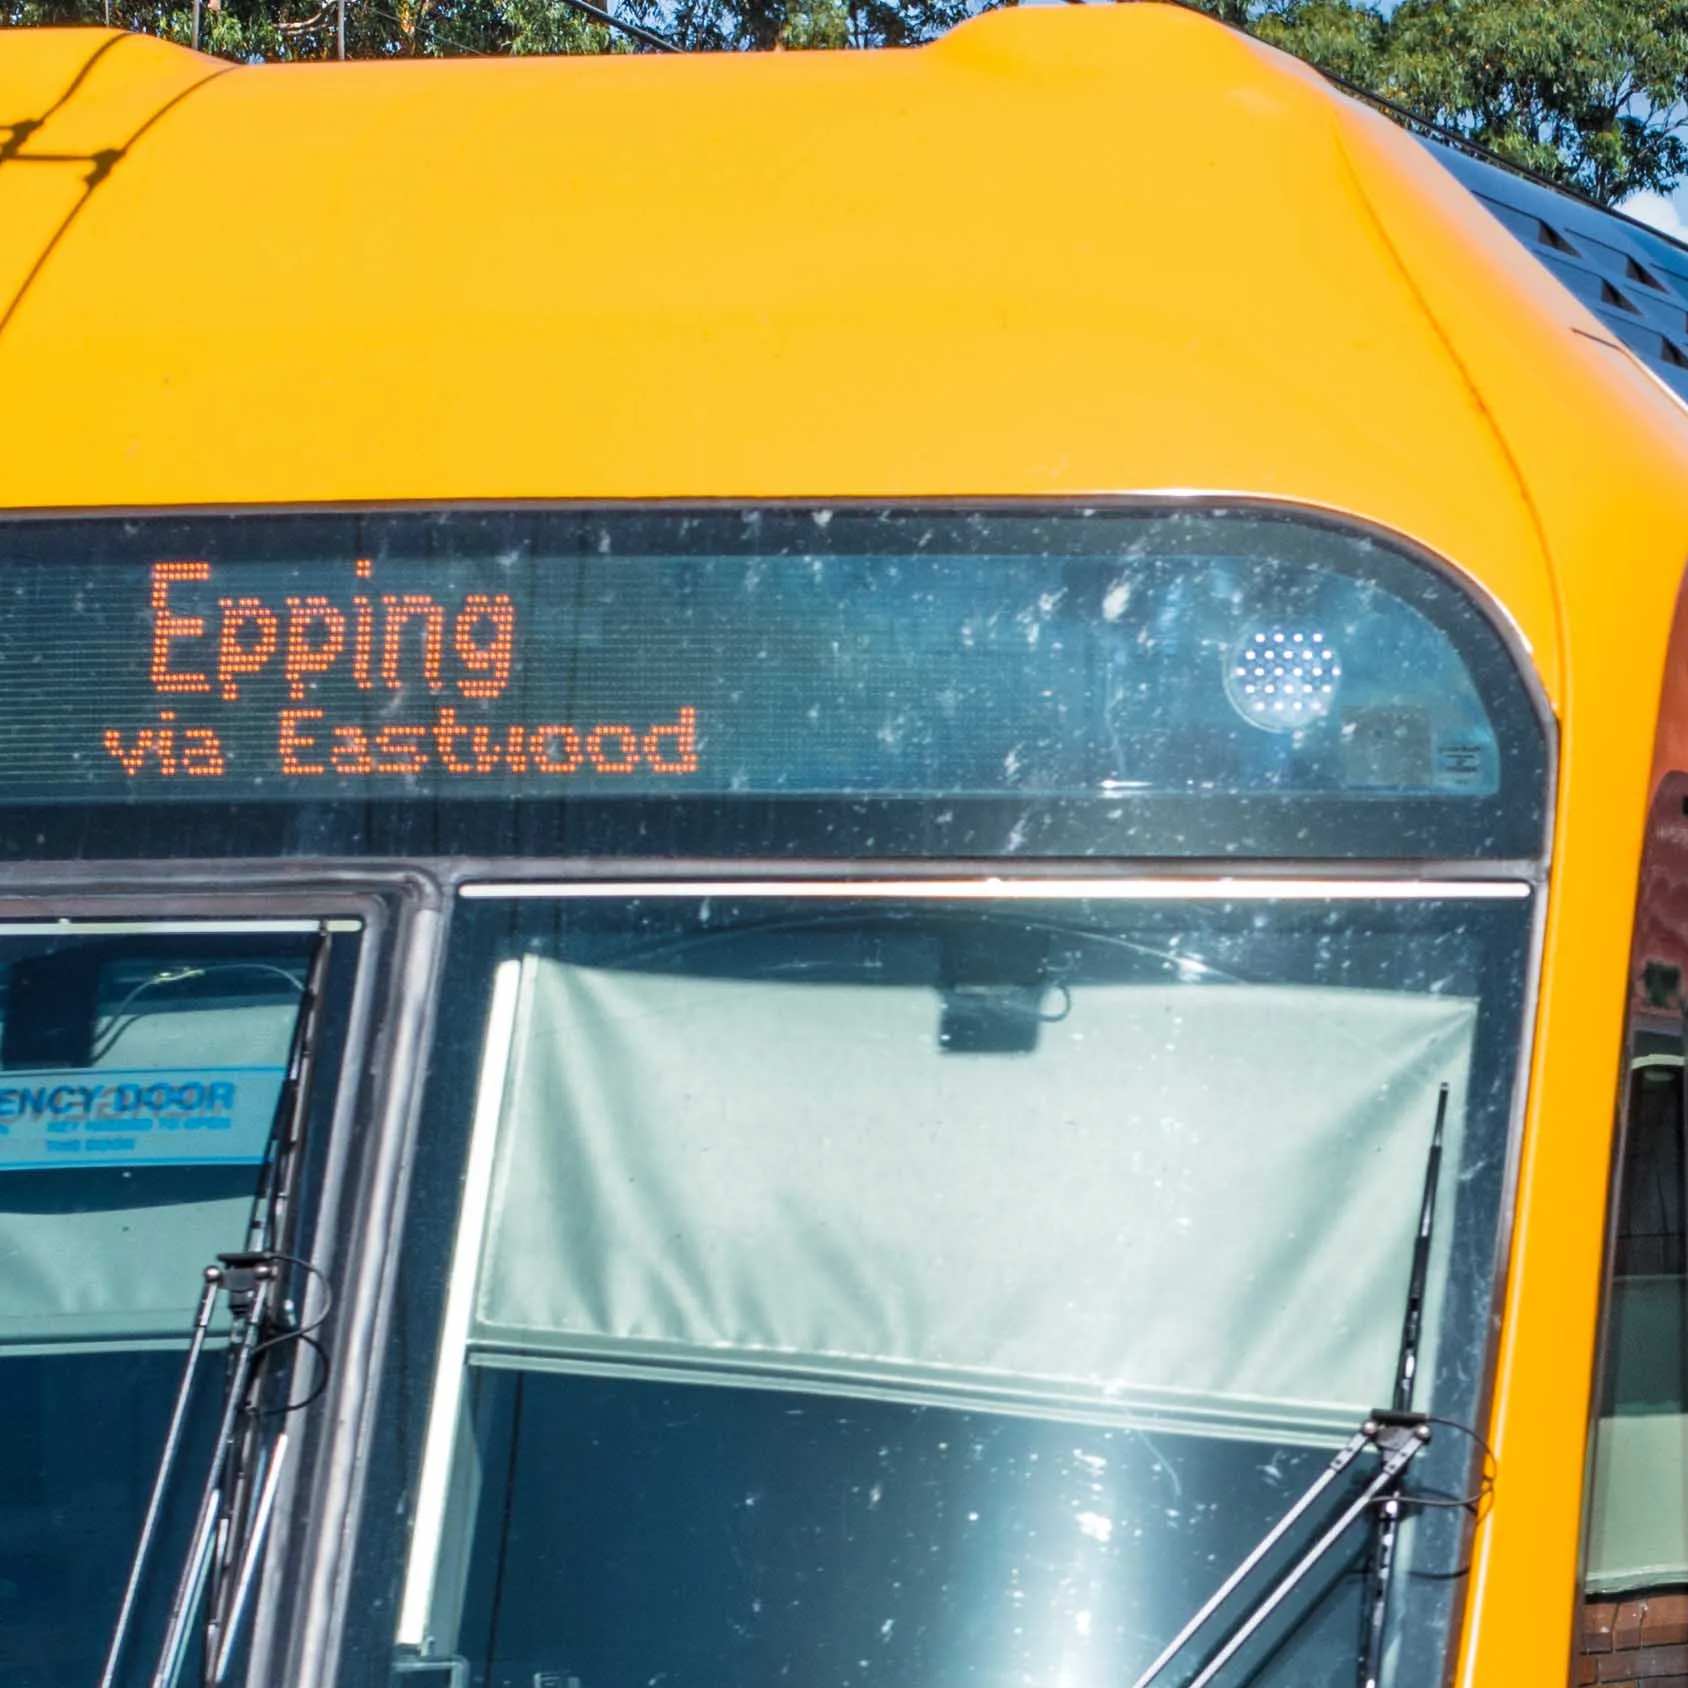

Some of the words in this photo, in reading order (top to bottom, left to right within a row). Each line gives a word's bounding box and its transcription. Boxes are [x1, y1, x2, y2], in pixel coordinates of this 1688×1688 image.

[151, 559, 513, 700] Epping
[104, 711, 224, 775] via
[279, 707, 698, 775] Eastwood
[113, 1081, 236, 1112] DOOR
